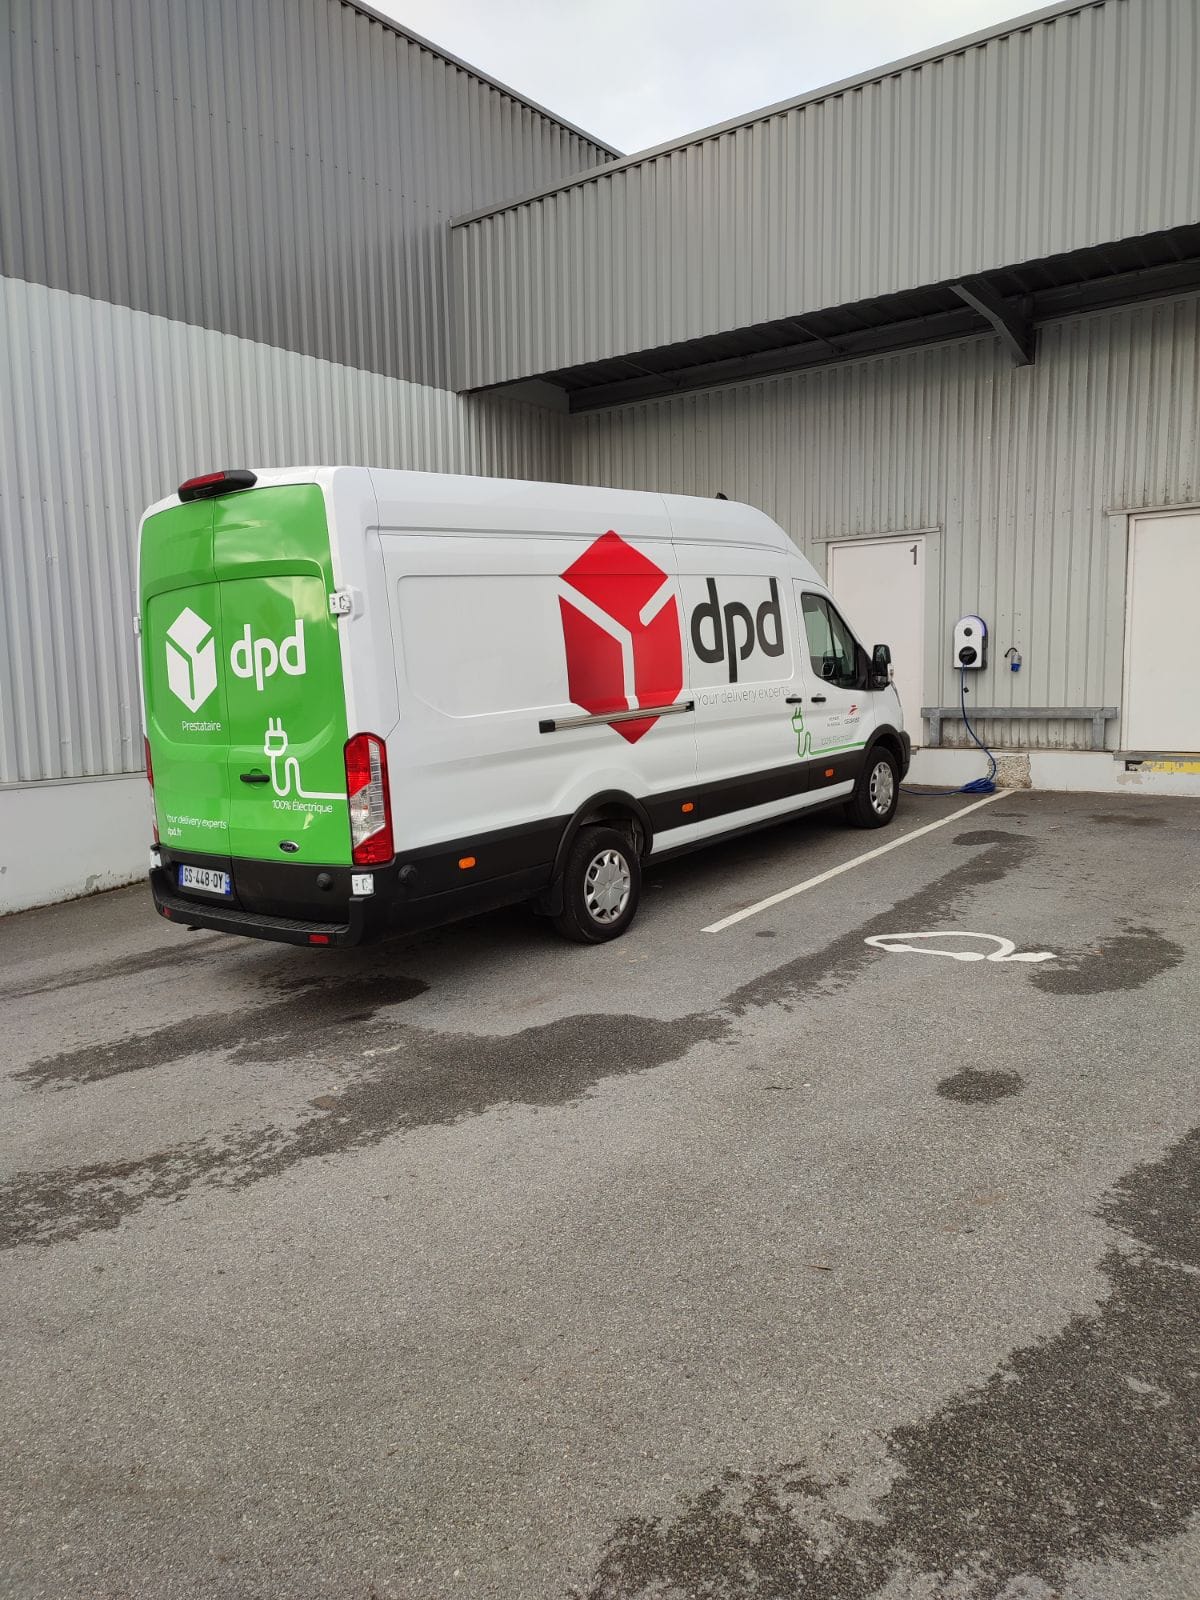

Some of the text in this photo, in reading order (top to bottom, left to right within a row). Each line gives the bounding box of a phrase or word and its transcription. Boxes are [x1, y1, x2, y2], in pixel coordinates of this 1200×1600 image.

[910, 545, 918, 565] 1
[690, 577, 785, 683] dpd
[230, 618, 307, 691] dpd
[695, 686, 791, 705] Your delivery experts
[181, 720, 222, 732] Prestataire
[272, 798, 333, 815] 100% Électrique
[178, 815, 201, 828] delivery
[202, 818, 227, 830] experts
